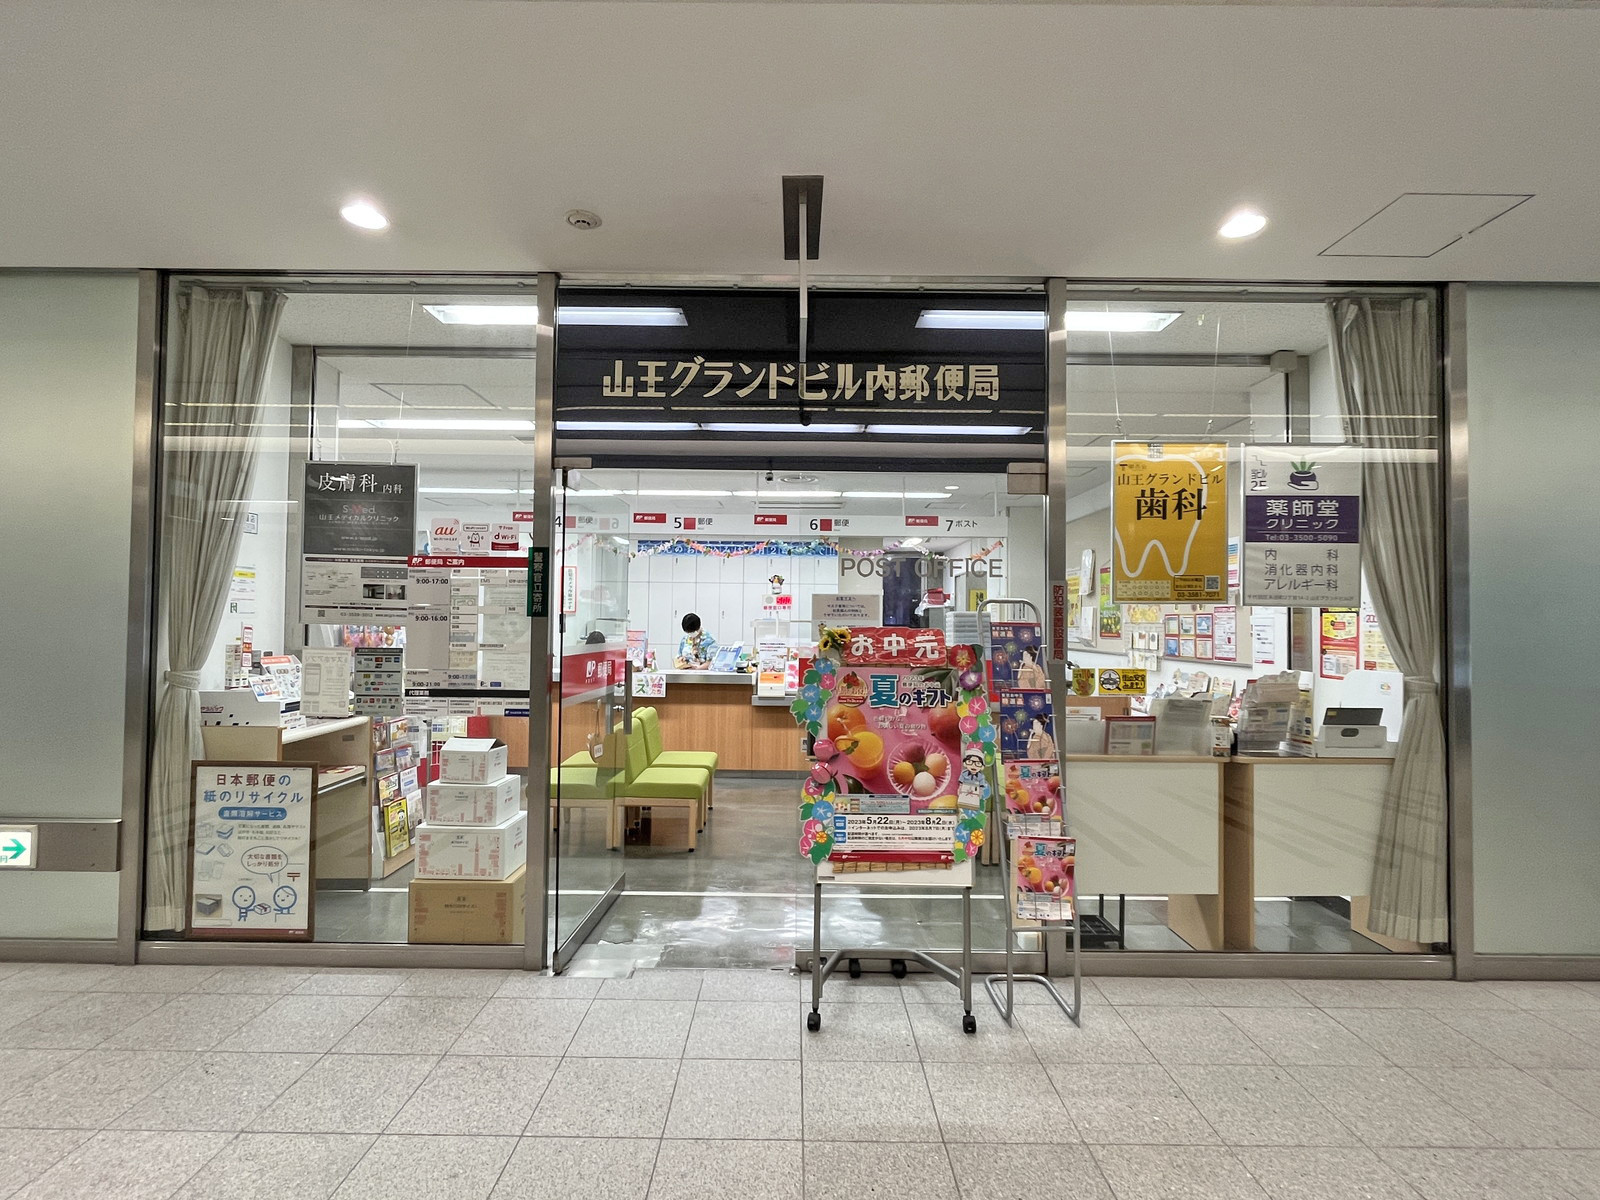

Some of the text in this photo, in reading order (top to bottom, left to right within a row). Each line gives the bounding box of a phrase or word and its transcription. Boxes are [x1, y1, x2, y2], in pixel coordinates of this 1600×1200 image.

[602, 355, 1000, 401] 山王グランドビル内郵便局
[318, 473, 402, 494] 皮膚科 内科
[1117, 473, 1224, 486] 山王グランドビル
[1134, 488, 1207, 521] 歯科
[1266, 499, 1339, 517] 薬師堂
[319, 515, 399, 523] 山王メディカルクリニック
[555, 516, 562, 528] 4
[674, 517, 713, 528] 5 郵便
[810, 518, 850, 531] 6 郵便
[945, 519, 978, 532] 7 ポスト
[1266, 519, 1339, 530] クリニック
[841, 558, 1003, 578] POST OFFICE
[1264, 564, 1338, 576] 消化器内科
[533, 551, 543, 613] 警察官立寄所
[1264, 578, 1338, 591] アレルギー科
[851, 633, 940, 659] お中元
[869, 674, 952, 708] 夏のギフト
[216, 773, 291, 787] 日本郵便の
[203, 790, 304, 804] 紙のリサイクル
